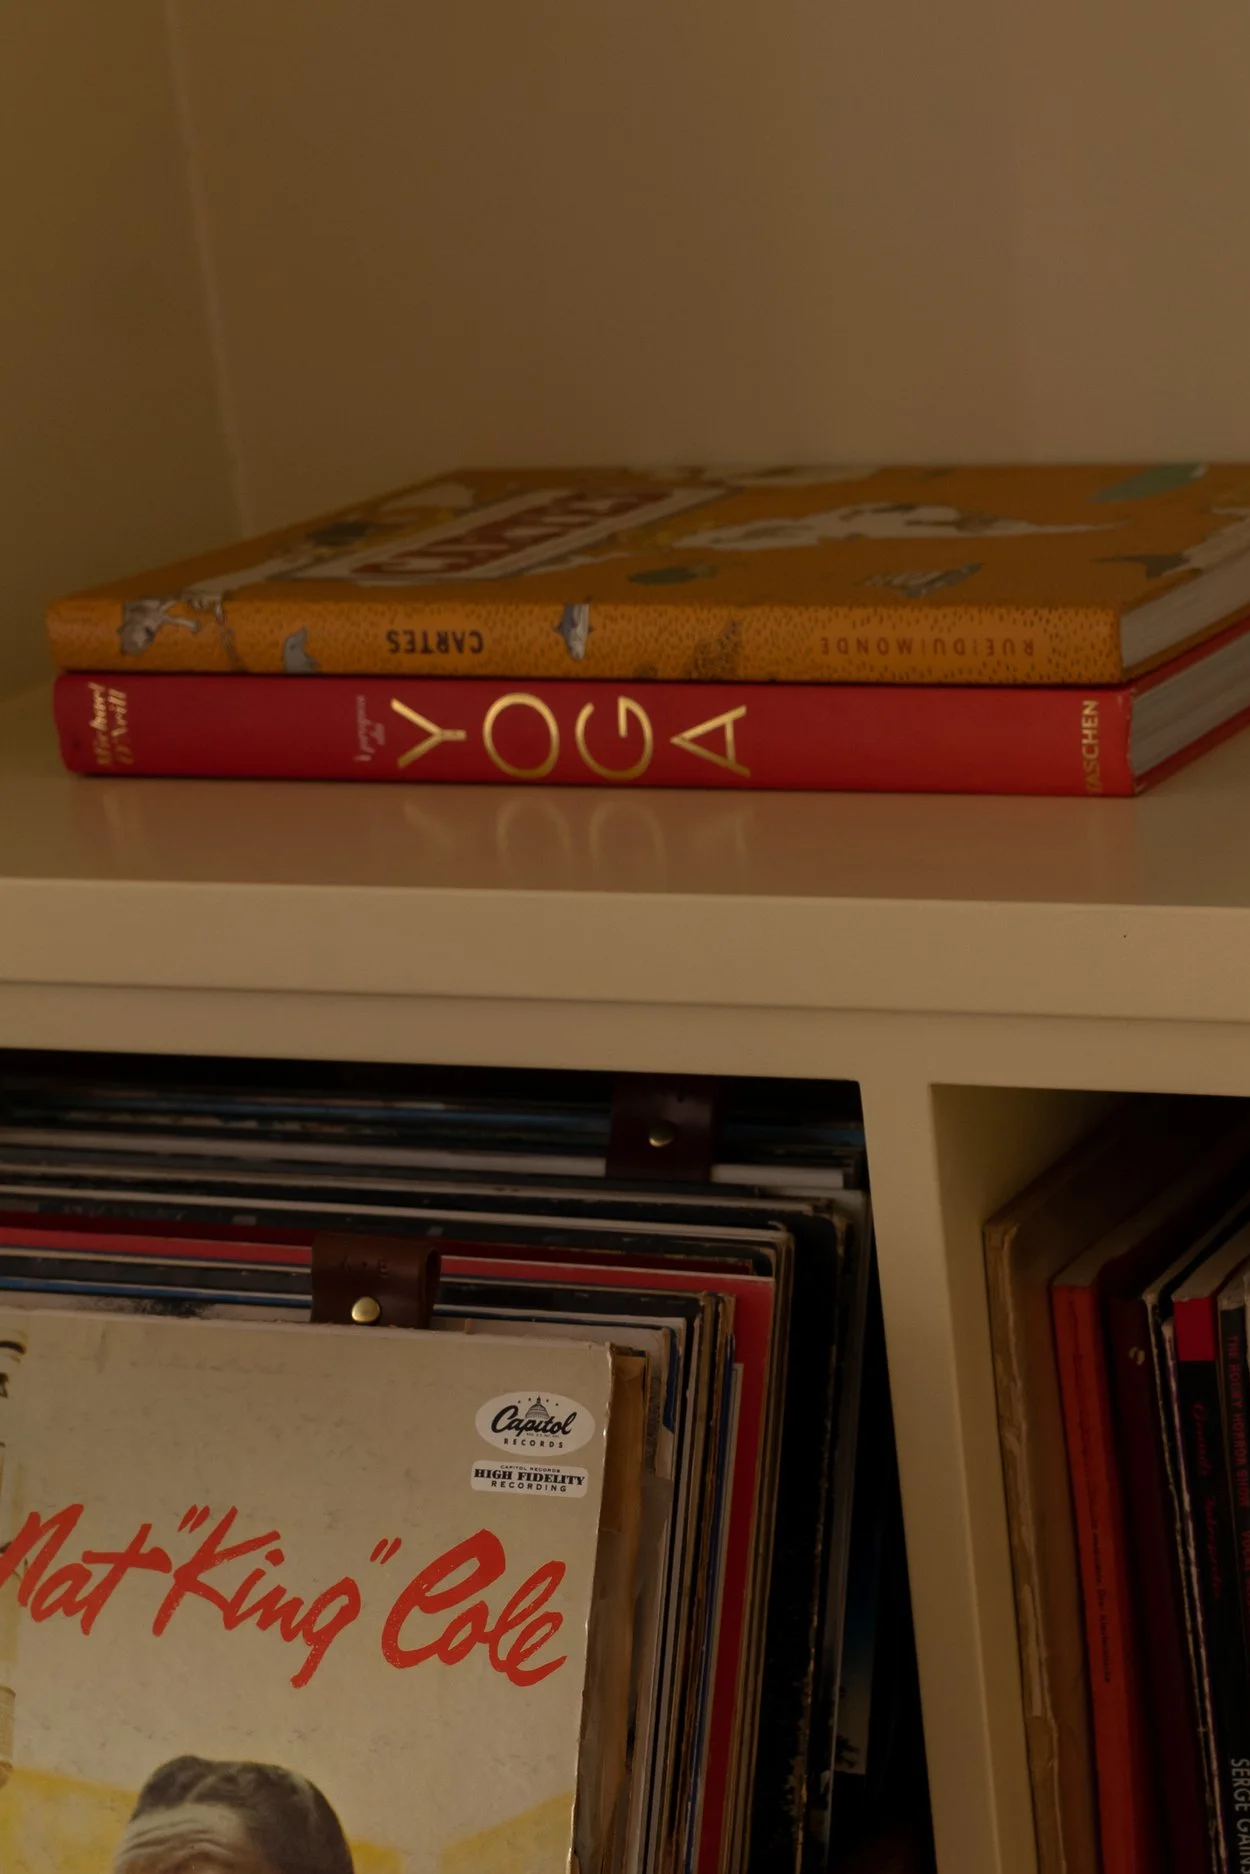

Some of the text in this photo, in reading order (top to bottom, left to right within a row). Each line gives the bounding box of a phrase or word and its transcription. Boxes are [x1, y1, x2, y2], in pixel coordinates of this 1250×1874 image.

[385, 628, 485, 655] CARTES
[389, 691, 752, 781] YOGA
[1080, 699, 1103, 793] TASCHEN
[491, 1404, 578, 1437] Capitol
[1232, 1411, 1249, 1467] HORROR
[503, 1438, 564, 1448] RECORDS
[474, 1468, 585, 1485] HIGH FIDELITY
[491, 1480, 567, 1492] RECORDING
[1235, 1468, 1250, 1509] SHOW
[0, 1503, 173, 1636] Nat
[381, 1528, 568, 1687] Cole
